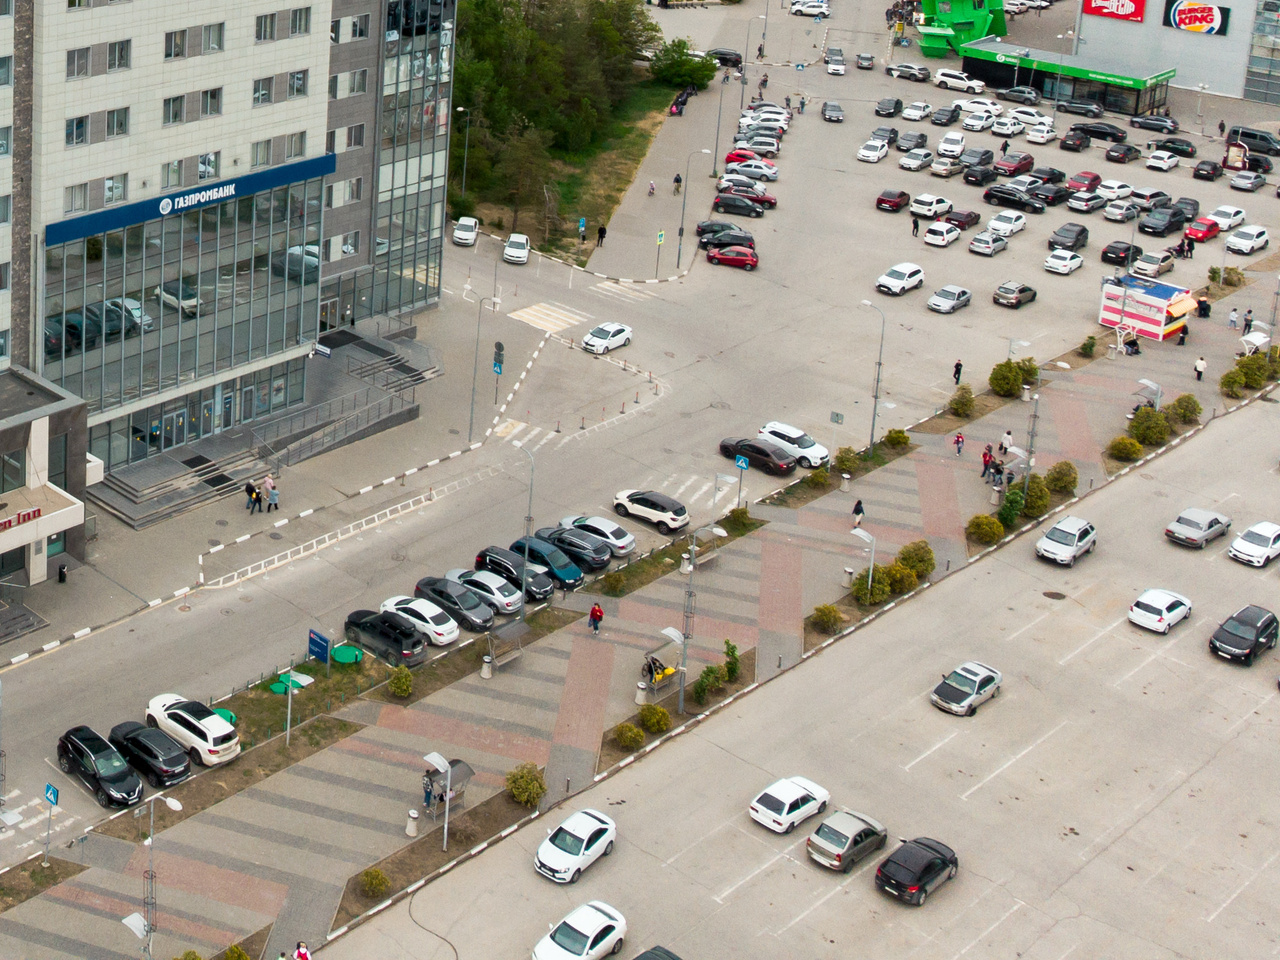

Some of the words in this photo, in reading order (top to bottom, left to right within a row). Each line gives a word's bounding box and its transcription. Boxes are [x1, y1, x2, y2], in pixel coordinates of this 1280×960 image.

[1177, 6, 1214, 17] BURGER
[1177, 13, 1214, 27] KING
[174, 183, 236, 209] ГАЗПРОМБАНК
[17, 507, 42, 525] Inn
